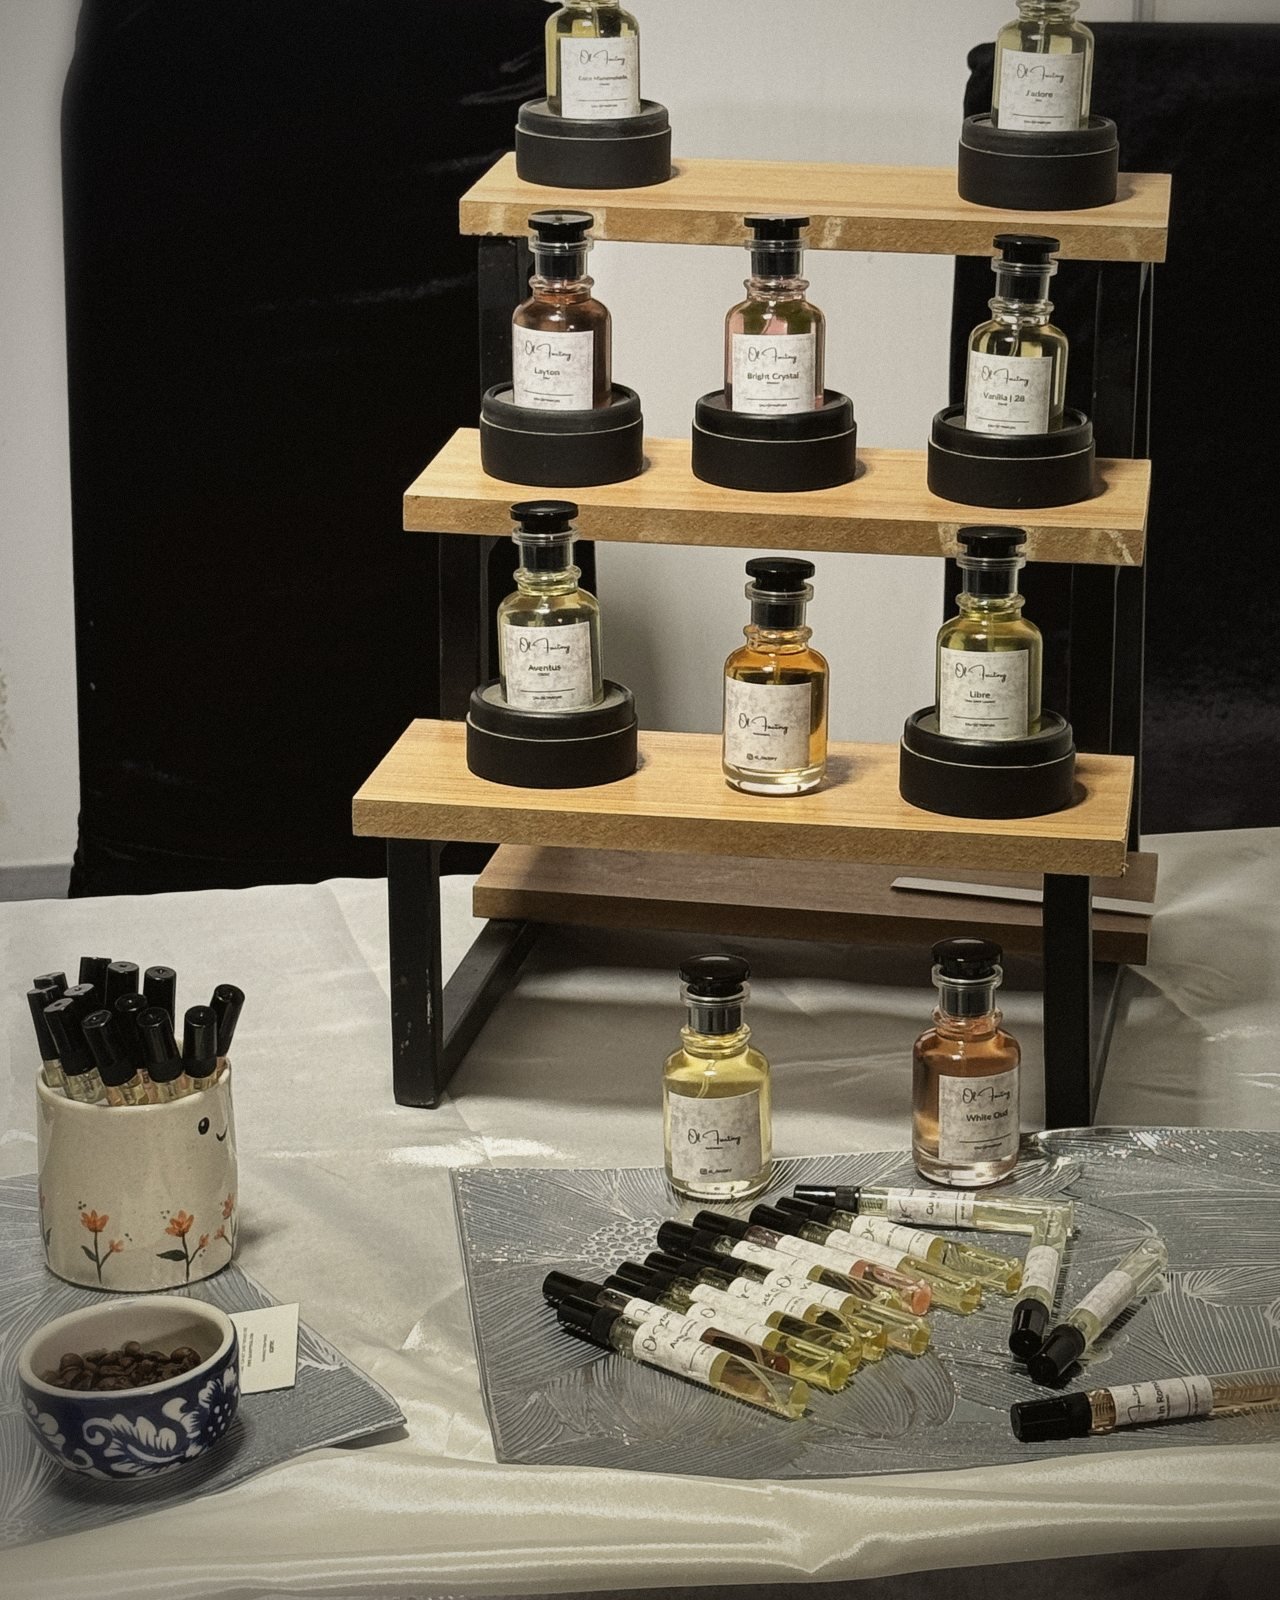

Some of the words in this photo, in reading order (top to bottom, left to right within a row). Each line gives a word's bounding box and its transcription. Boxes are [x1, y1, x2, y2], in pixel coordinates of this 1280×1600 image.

[534, 367, 561, 377] Layton
[747, 373, 770, 381] Bright
[772, 371, 800, 381] Crystal
[983, 392, 1008, 401] Vanilla
[528, 664, 561, 672] Aventus
[969, 690, 991, 699] Libre
[966, 1113, 992, 1122] White
[993, 1108, 1009, 1119] Oud
